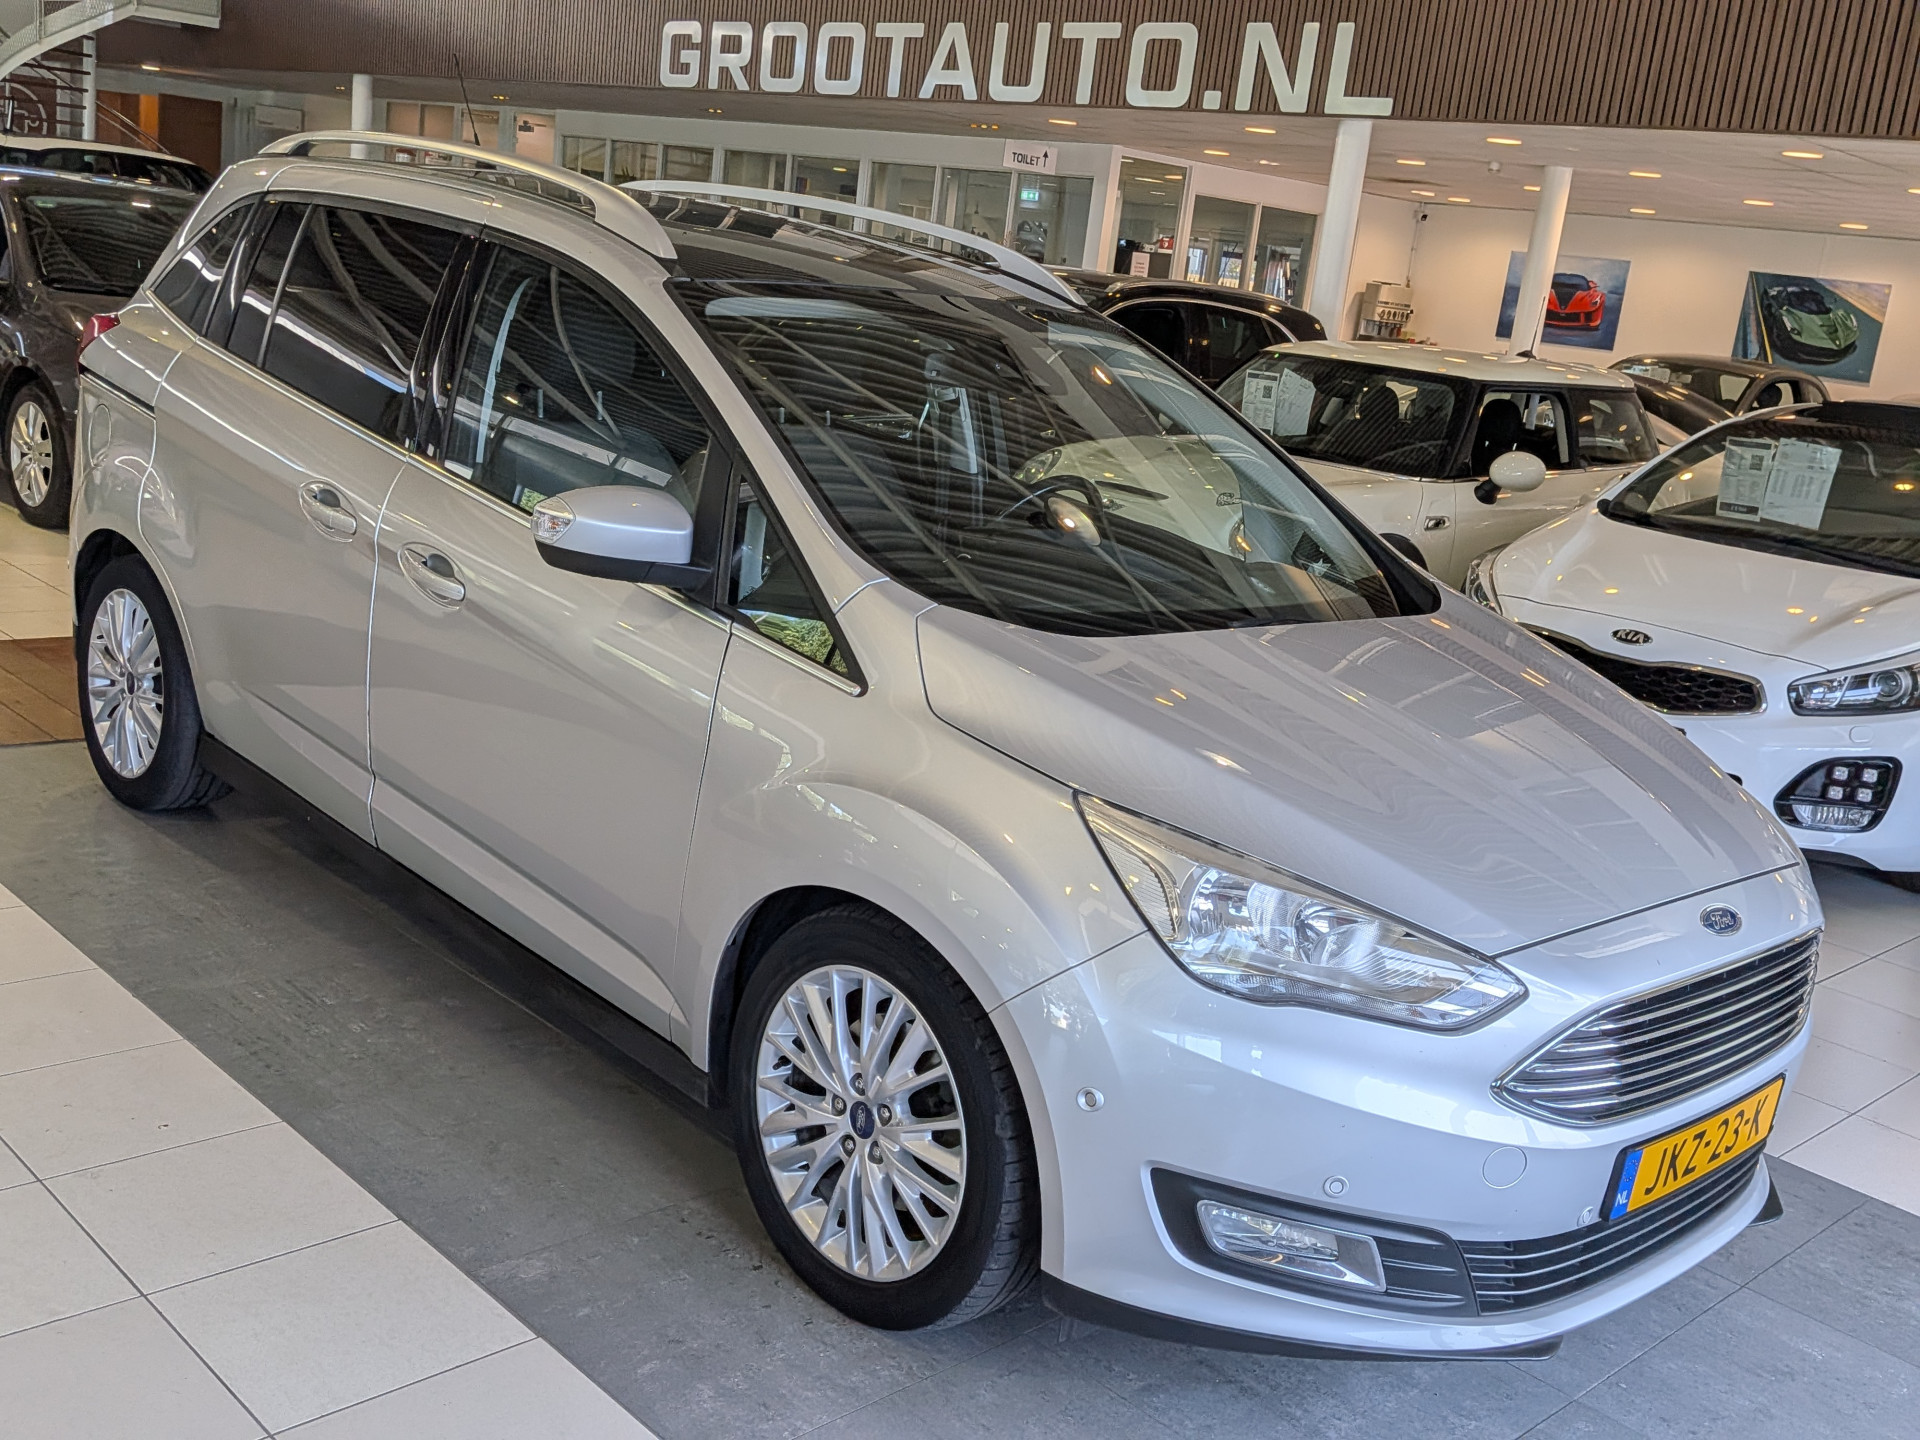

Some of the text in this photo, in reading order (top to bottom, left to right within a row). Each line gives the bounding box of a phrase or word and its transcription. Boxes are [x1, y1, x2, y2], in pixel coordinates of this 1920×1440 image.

[658, 20, 1394, 117] GROOTAUTO.NL
[1012, 152, 1040, 166] TOILET
[1616, 630, 1645, 644] KIA
[1705, 910, 1734, 930] Ford
[1644, 1094, 1769, 1195] JKZ-23-K
[1615, 1189, 1628, 1206] NL
